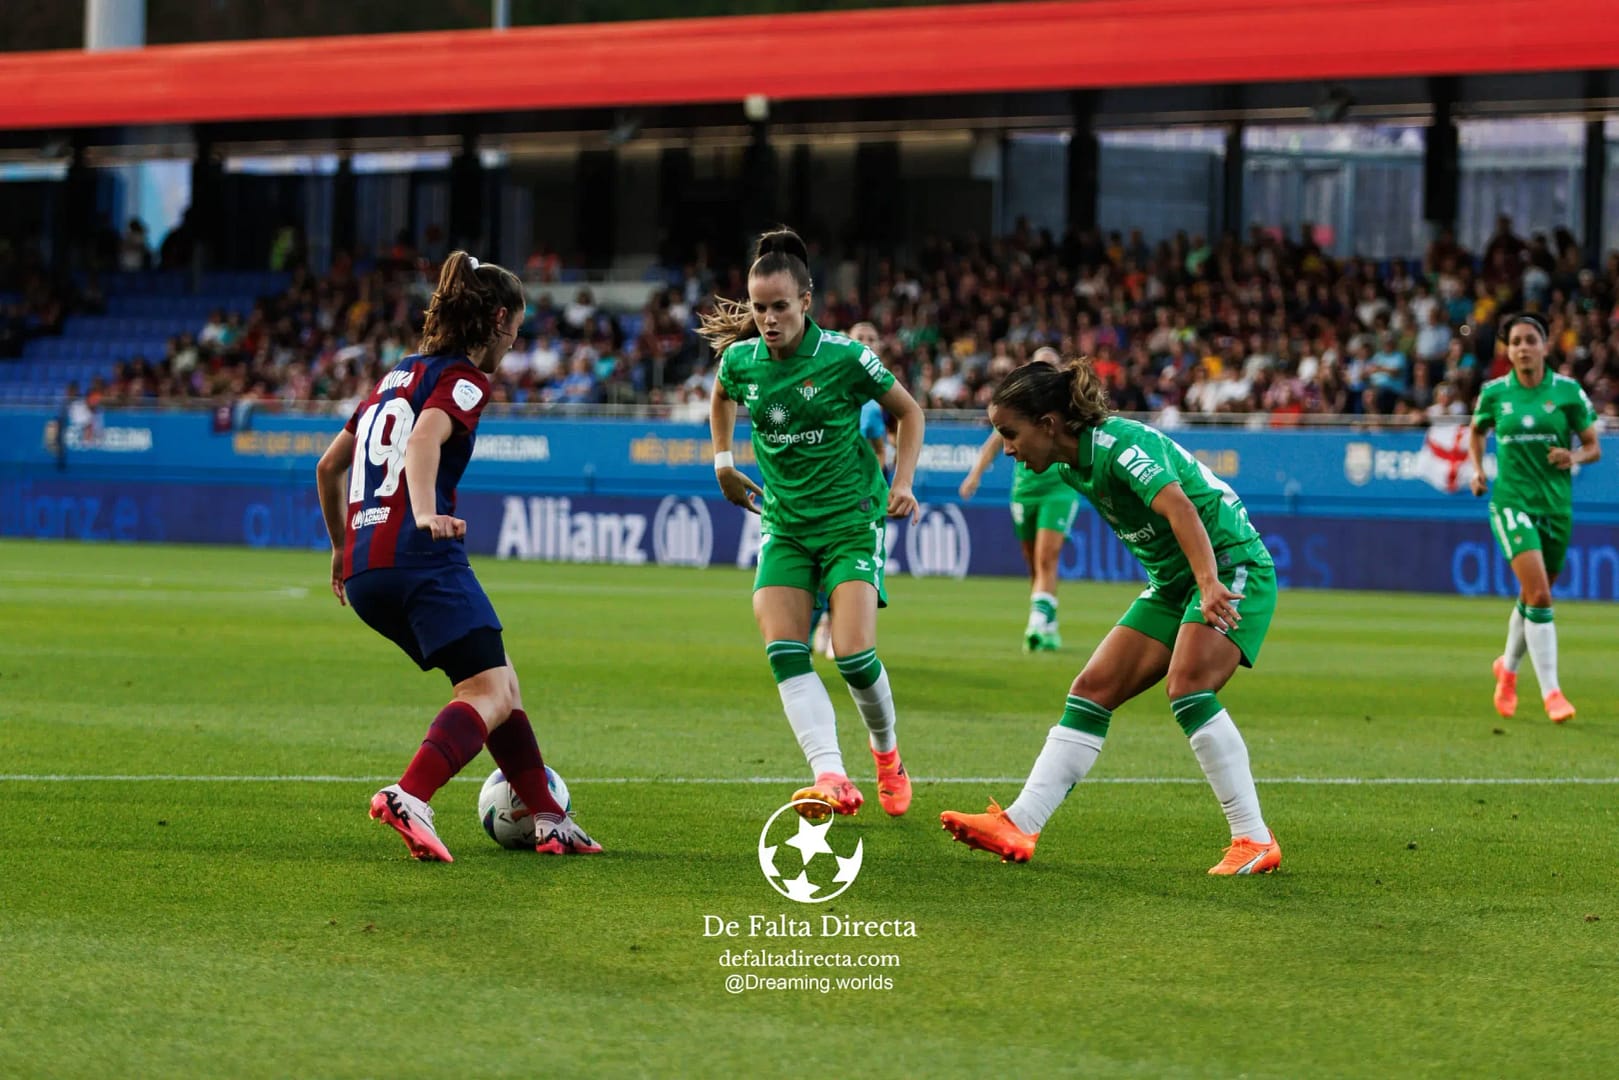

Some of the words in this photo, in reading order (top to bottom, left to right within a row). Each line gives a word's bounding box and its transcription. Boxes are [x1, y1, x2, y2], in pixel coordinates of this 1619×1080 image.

[349, 397, 415, 503] 19
[497, 496, 647, 561] Allianz
[1503, 507, 1533, 531] 14
